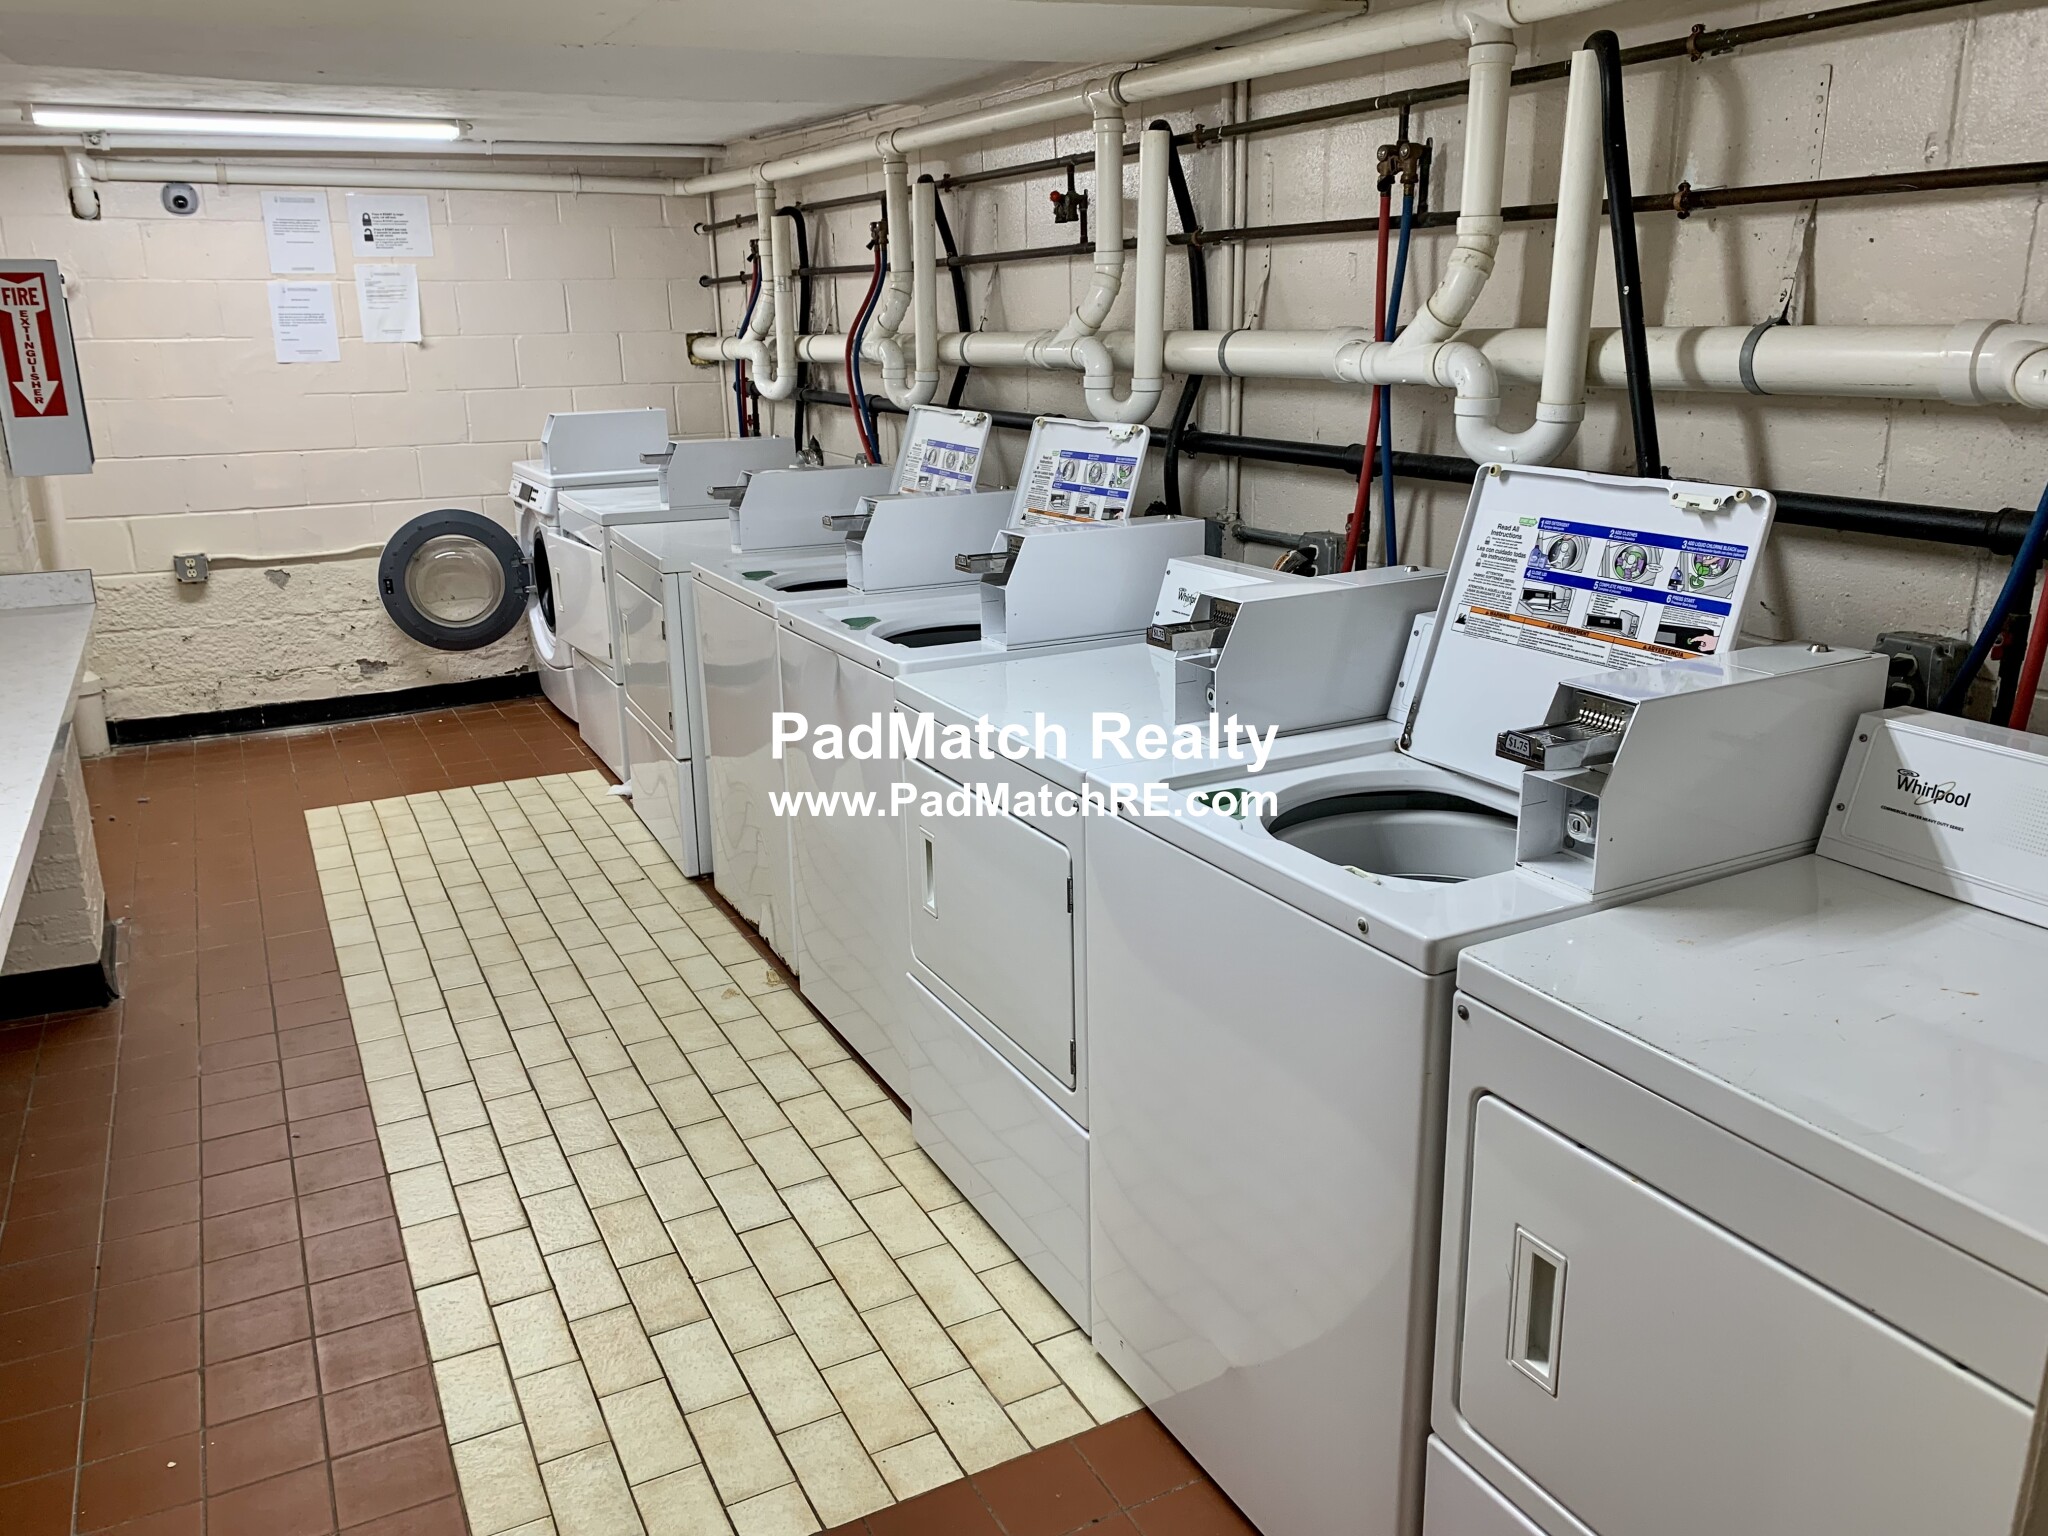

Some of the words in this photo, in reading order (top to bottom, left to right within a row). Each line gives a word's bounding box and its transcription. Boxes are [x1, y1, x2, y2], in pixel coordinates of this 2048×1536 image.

[1, 287, 39, 306] FIRE
[19, 310, 44, 404] EXTINGUISHER
[1490, 529, 1522, 539] Instructions
[1609, 529, 1615, 538] 2
[1682, 540, 1687, 549] 3
[1494, 547, 1513, 556] cuidado
[1512, 550, 1527, 558] todas
[1526, 569, 1531, 577] 4
[1593, 581, 1599, 589] 5
[1666, 595, 1672, 603] 6
[1508, 736, 1528, 752] $1.75
[1897, 775, 1971, 808] Whirlpool
